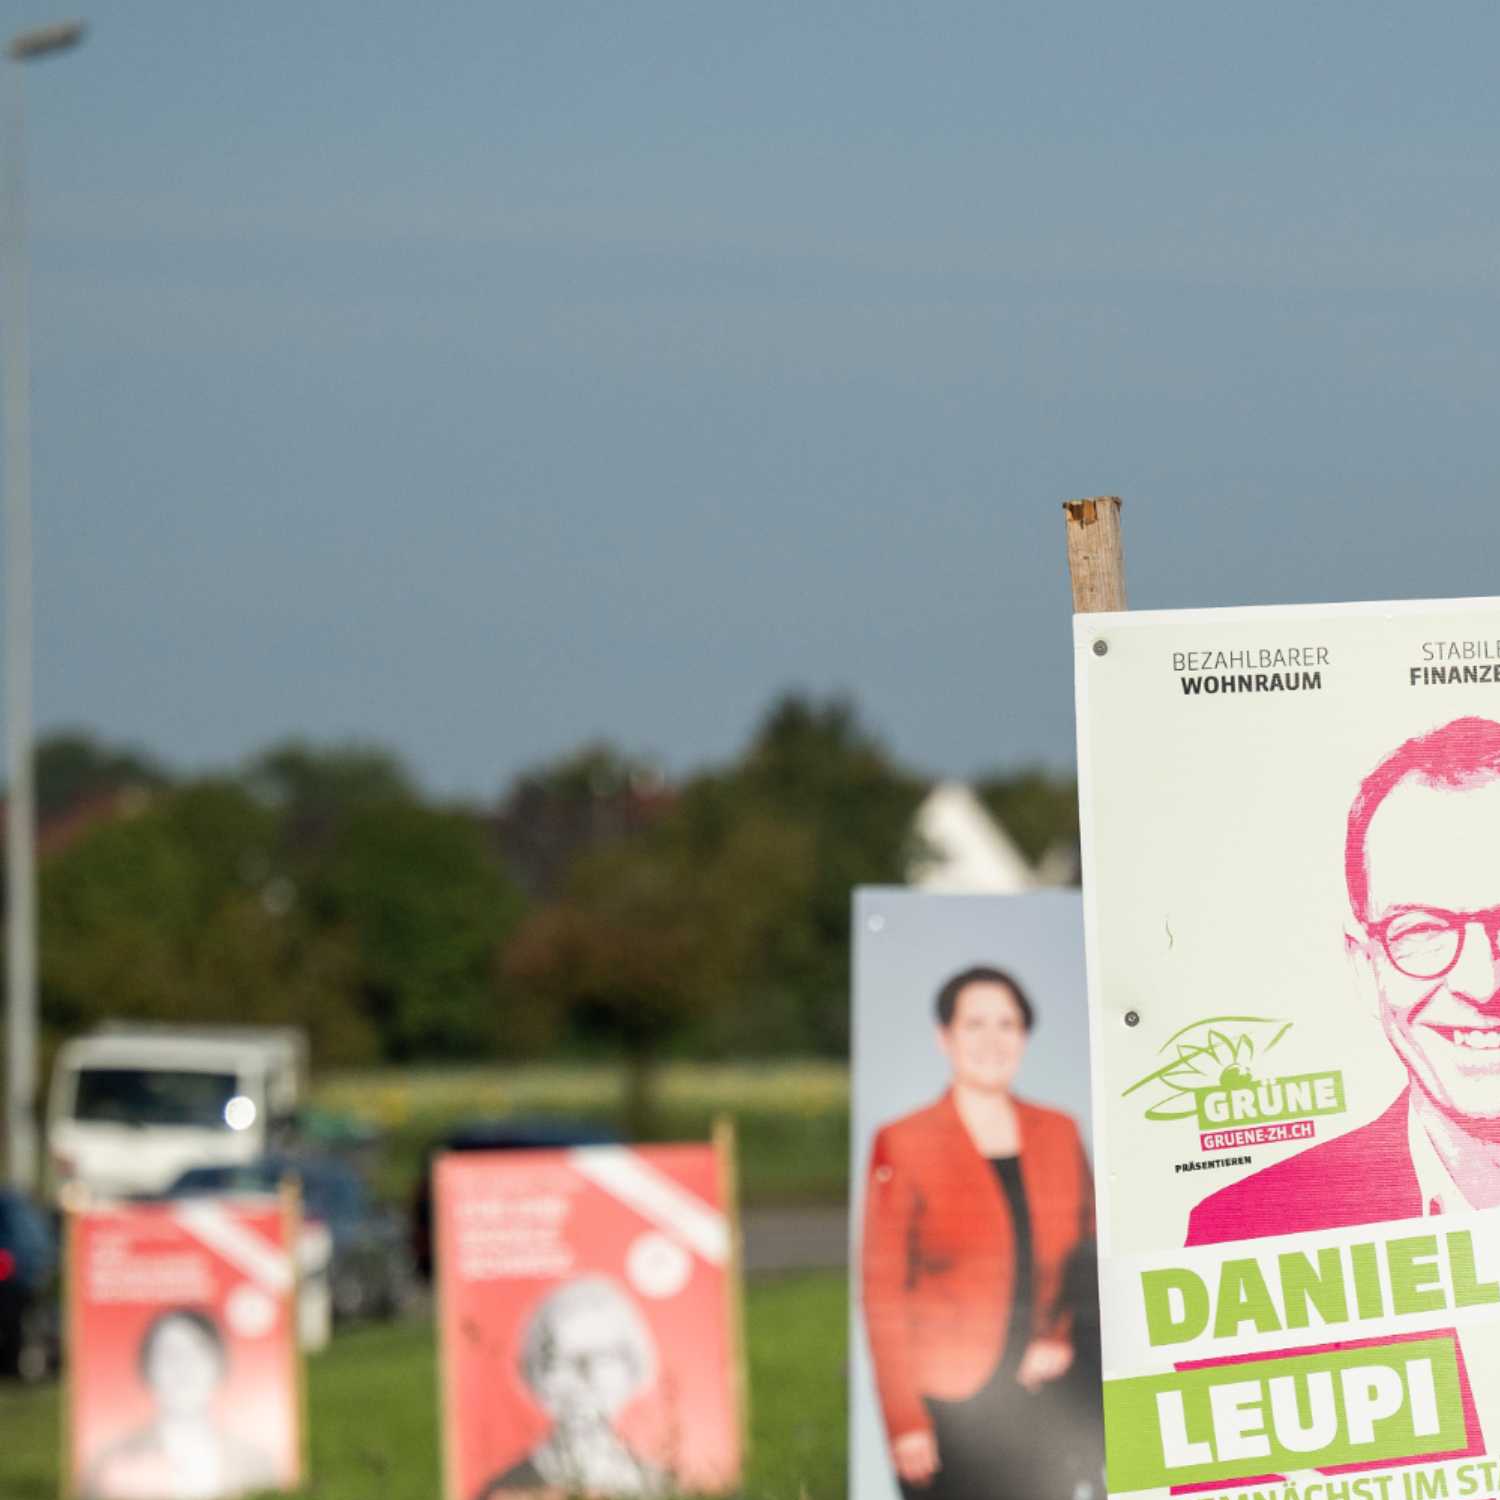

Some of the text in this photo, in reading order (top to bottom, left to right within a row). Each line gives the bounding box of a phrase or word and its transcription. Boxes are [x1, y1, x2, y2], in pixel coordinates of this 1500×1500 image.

[1172, 646, 1330, 671] BEZAHLBARER
[1180, 671, 1322, 695] WOHNRAUM
[1203, 1077, 1338, 1122] GRÜNE
[1202, 1122, 1313, 1149] GRUENE-ZH.CH
[1174, 1155, 1252, 1173] PRÄSENTIEREN
[1155, 1358, 1441, 1469] LEUPI
